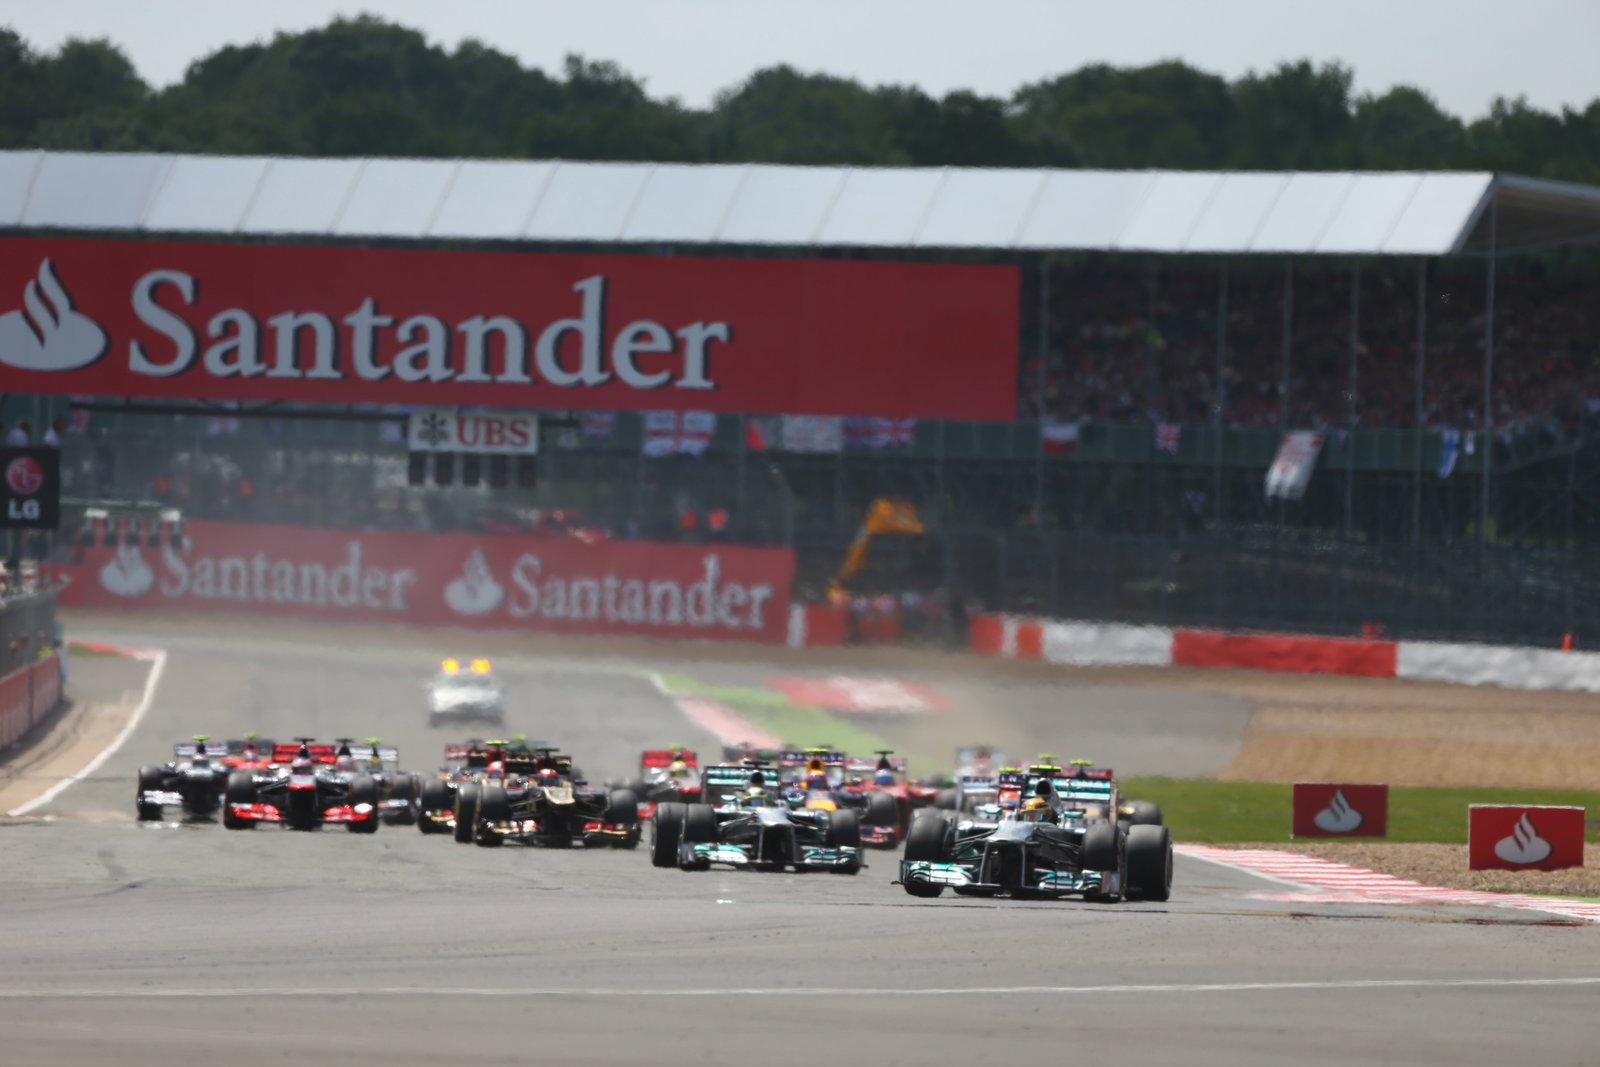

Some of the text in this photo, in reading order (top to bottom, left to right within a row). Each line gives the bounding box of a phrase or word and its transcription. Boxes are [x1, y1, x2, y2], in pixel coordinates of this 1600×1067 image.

[128, 269, 730, 390] Santander
[455, 416, 530, 447] UBS
[9, 499, 40, 519] LG
[160, 537, 416, 610] Santander
[508, 553, 774, 629] Santander
